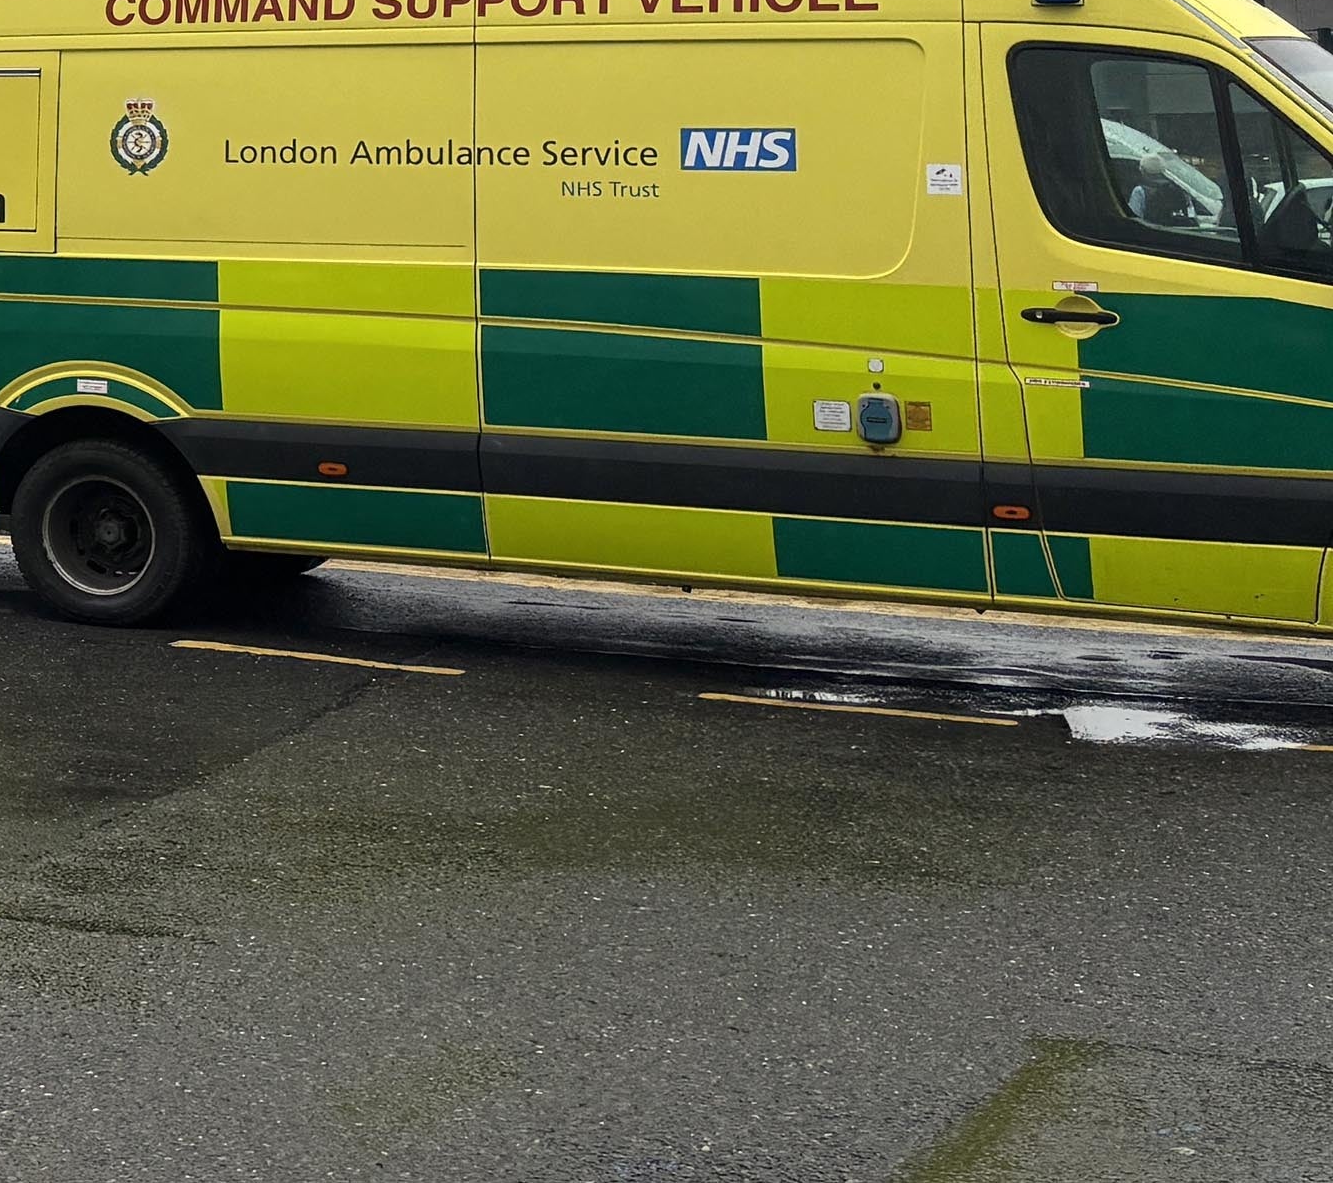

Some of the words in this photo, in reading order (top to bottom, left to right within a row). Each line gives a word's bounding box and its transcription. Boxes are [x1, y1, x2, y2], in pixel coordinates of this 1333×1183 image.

[224, 138, 337, 164] London
[349, 138, 531, 166] Ambulance
[542, 139, 658, 167] Service
[684, 131, 792, 168] NHS
[561, 180, 602, 197] NHS
[609, 180, 660, 198] Trust
